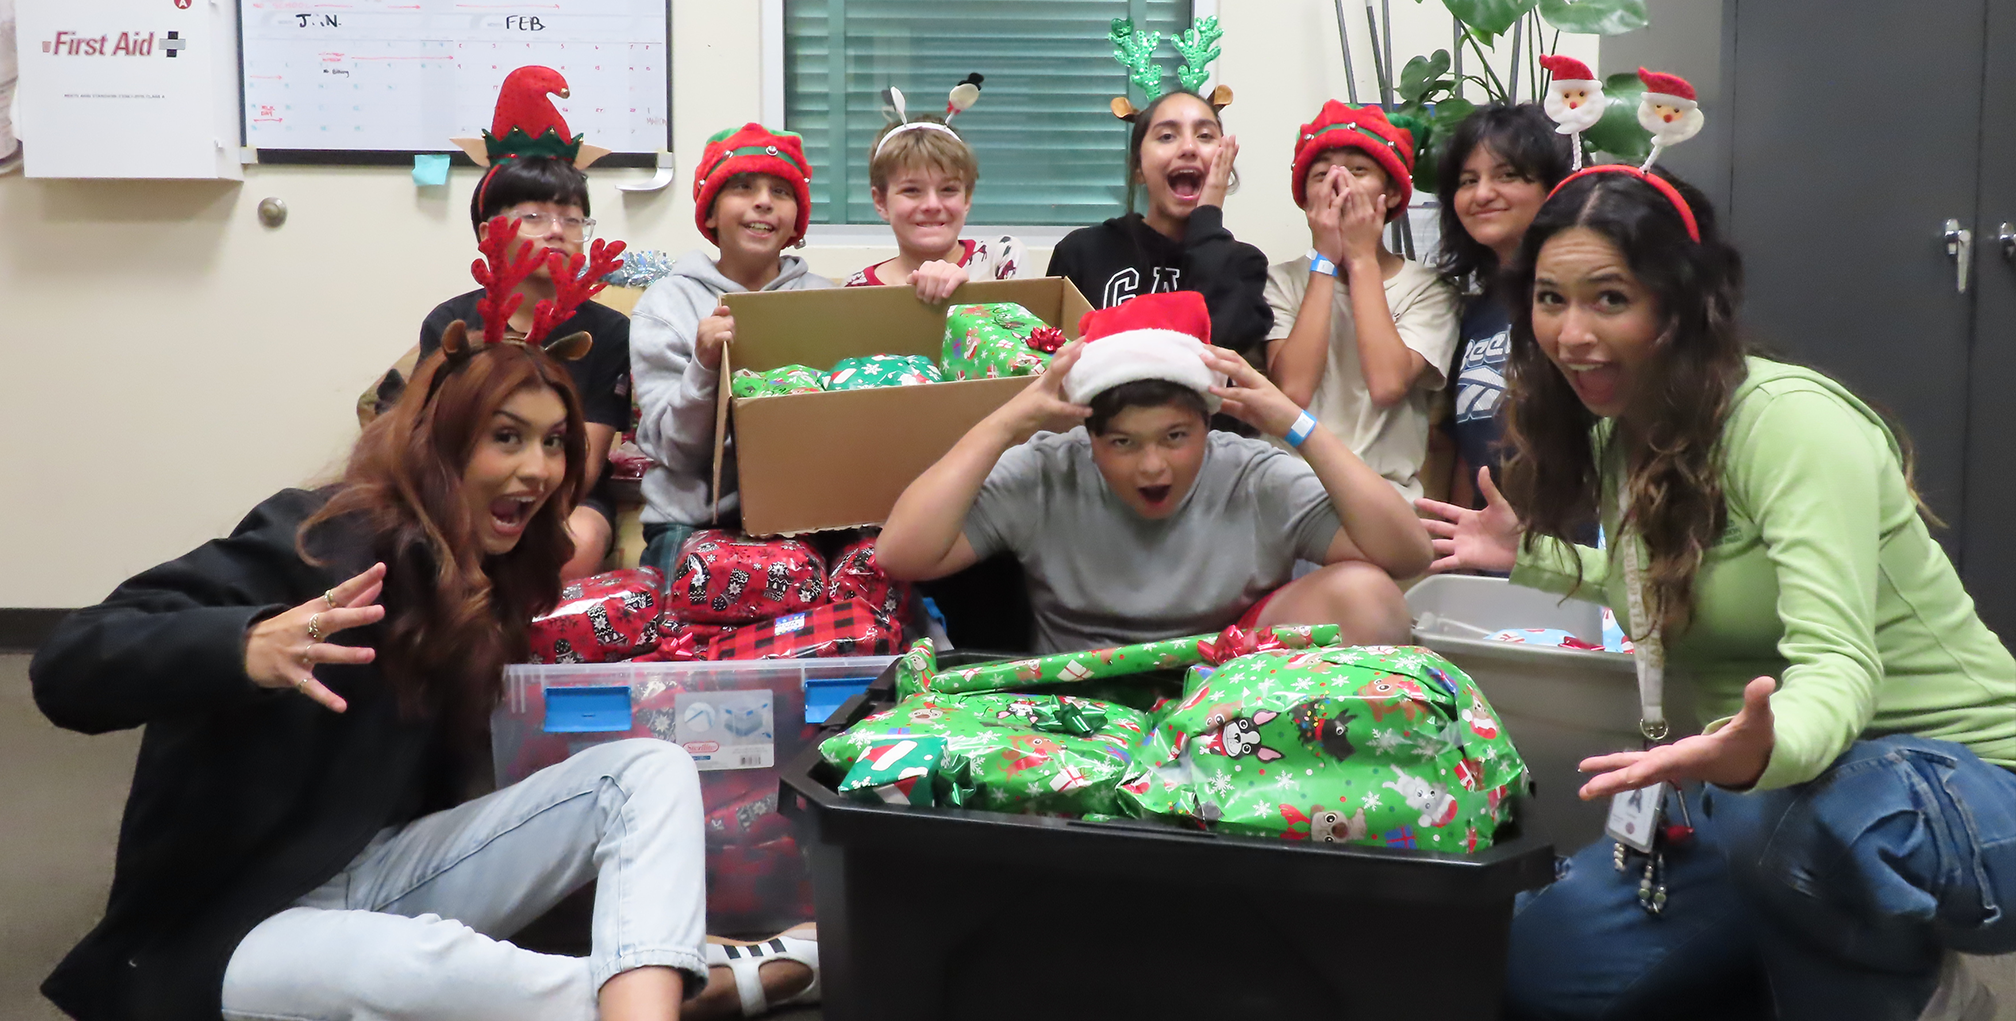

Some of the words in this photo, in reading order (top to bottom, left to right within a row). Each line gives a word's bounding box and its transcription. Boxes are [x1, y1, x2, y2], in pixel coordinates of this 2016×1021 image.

[506, 15, 546, 31] FEB
[53, 31, 109, 56] First
[111, 31, 155, 56] Aid
